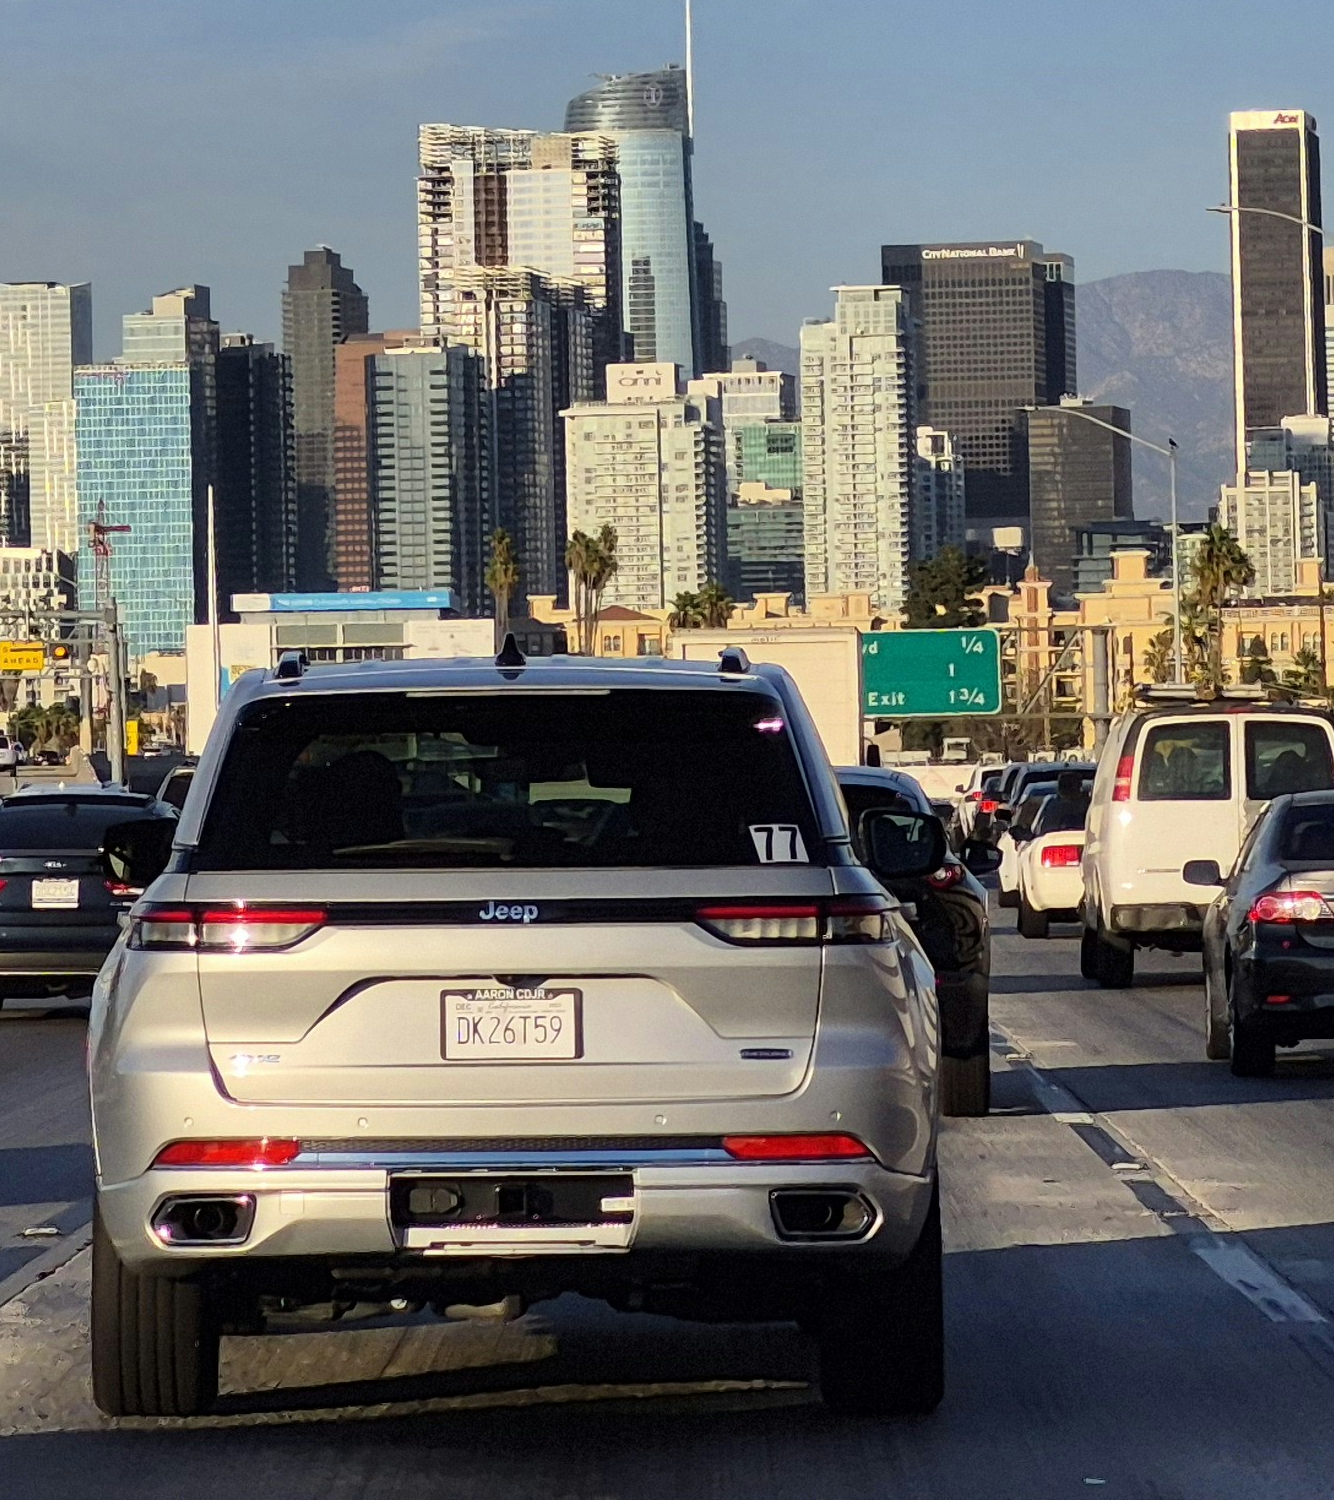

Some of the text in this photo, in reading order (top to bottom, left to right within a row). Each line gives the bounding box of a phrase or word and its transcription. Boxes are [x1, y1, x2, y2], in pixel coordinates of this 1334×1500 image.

[948, 663, 955, 677] 1
[868, 691, 906, 706] Exit
[479, 901, 539, 923] Jeep
[475, 988, 546, 1000] AARON CDJR
[456, 1015, 563, 1045] DK26T59
